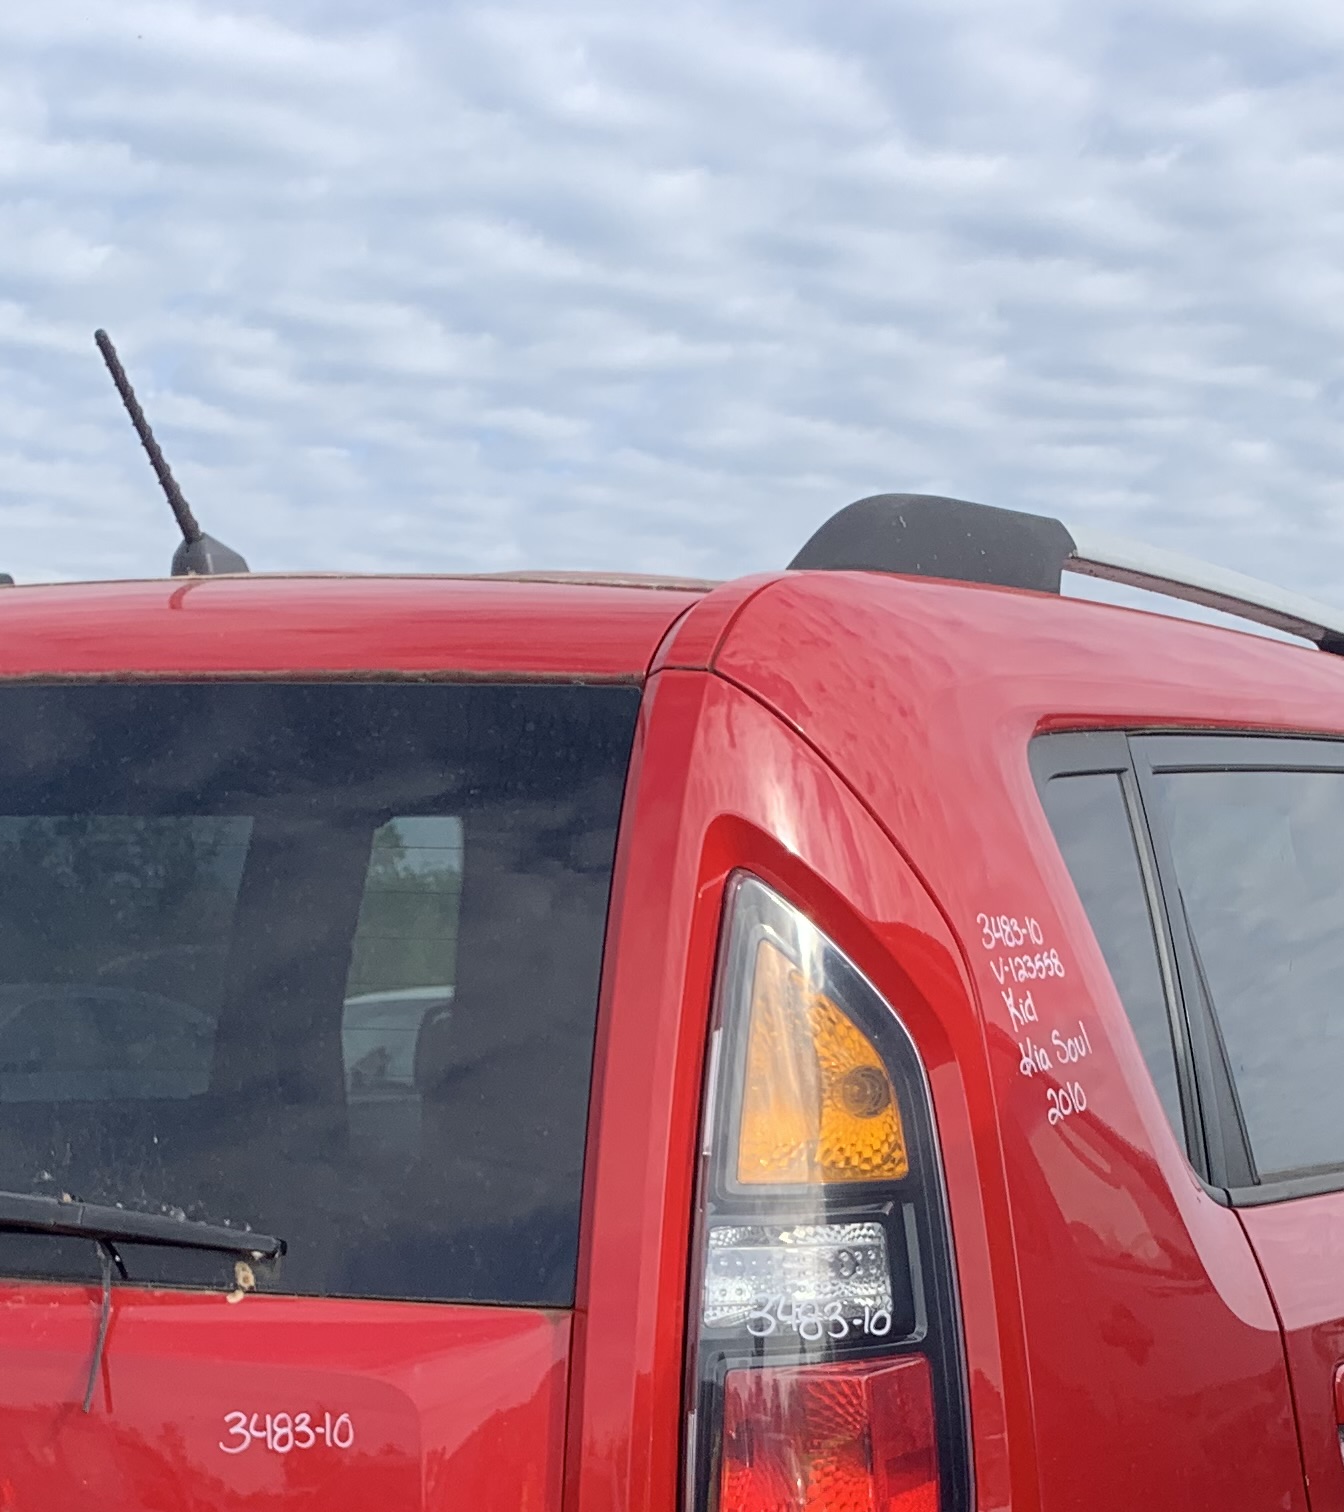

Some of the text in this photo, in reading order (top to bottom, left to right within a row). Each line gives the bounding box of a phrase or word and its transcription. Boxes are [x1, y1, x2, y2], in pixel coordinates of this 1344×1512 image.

[976, 912, 1044, 950] 3483-10
[1001, 987, 1039, 1033] Kid
[1018, 1020, 1093, 1078] Kia Soul
[1047, 1081, 1088, 1126] 2010
[746, 1293, 892, 1341] 3483-10
[218, 1410, 355, 1454] 3483-10
